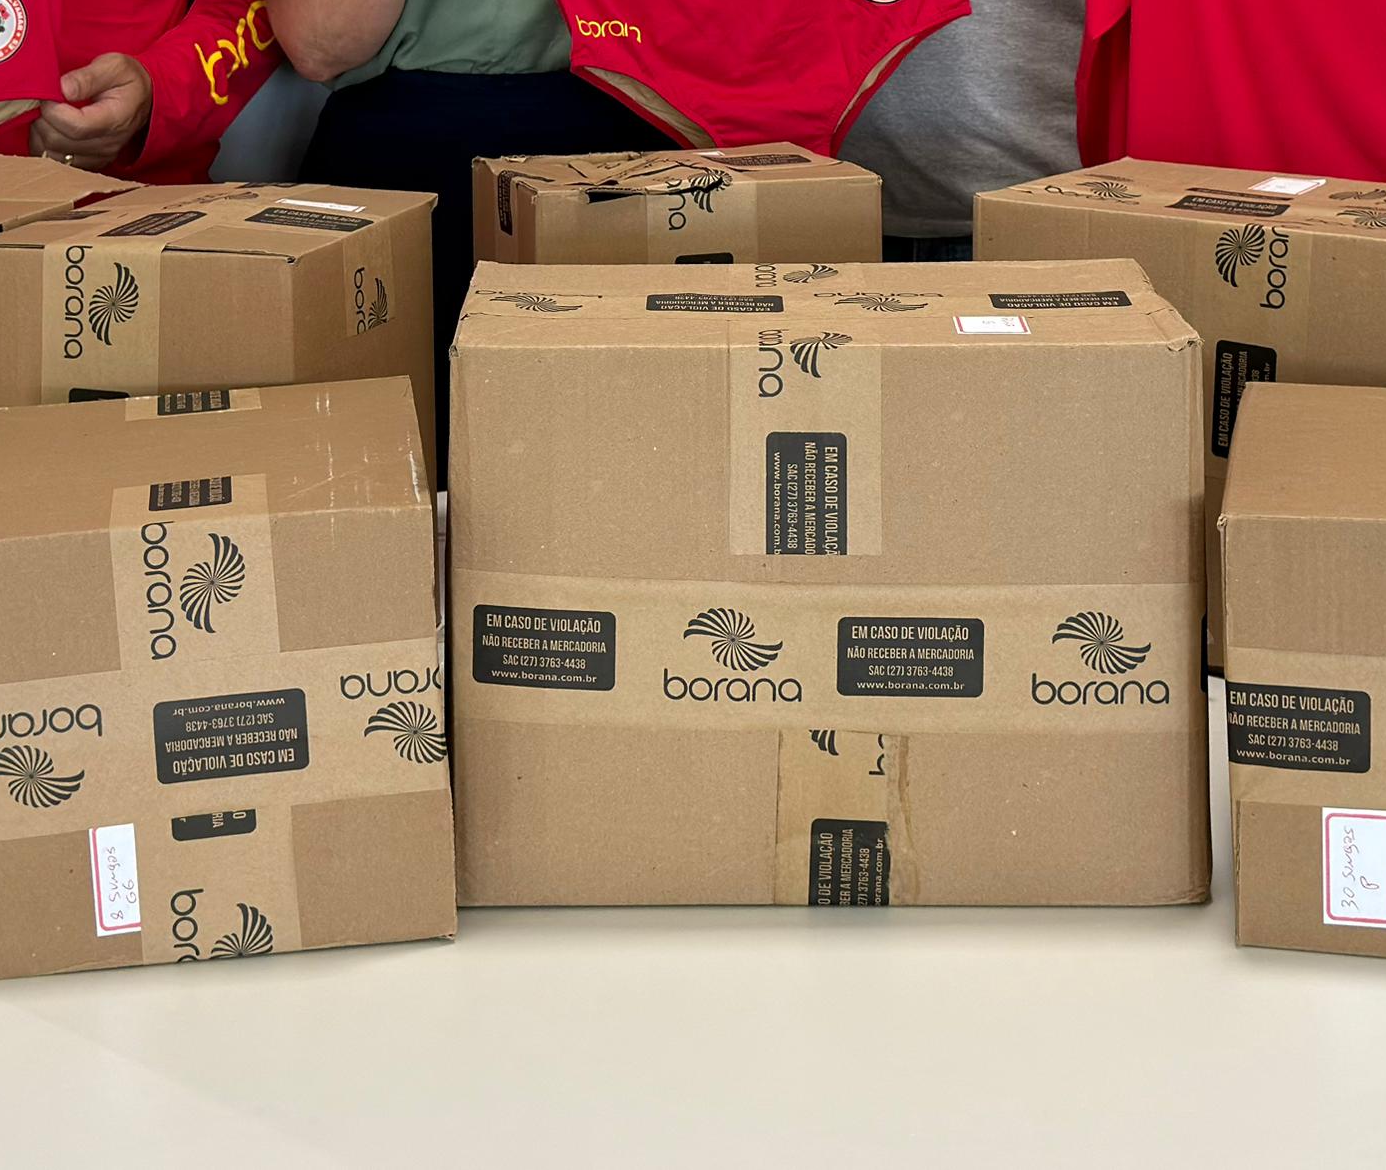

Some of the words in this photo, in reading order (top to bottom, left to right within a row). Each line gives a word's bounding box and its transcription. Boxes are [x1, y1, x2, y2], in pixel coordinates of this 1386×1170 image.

[64, 245, 93, 359] borana
[805, 442, 818, 461] NÃO
[825, 446, 838, 463] EM
[787, 464, 797, 480] SAC
[824, 465, 838, 493] CASO
[805, 462, 816, 502] RECEBER
[787, 483, 797, 502] (27)
[805, 503, 815, 511] A
[825, 495, 838, 510] DE
[787, 504, 797, 549] 3763-4438
[141, 520, 177, 660] borana
[486, 613, 502, 627] EM
[504, 615, 532, 630] CASO
[534, 617, 547, 631] DE
[550, 618, 601, 635] VIOLAÇÃO
[851, 625, 867, 639] EM
[870, 626, 898, 640] CASO
[901, 626, 915, 640] DE
[917, 625, 969, 643] VIOLAÇÃO
[482, 633, 500, 647] NÃO
[502, 636, 540, 650] RECEBER
[542, 639, 548, 651] A
[550, 639, 606, 653] MERCADORIA
[503, 654, 519, 666] SAC
[520, 655, 538, 668] (27)
[539, 657, 586, 669] 3763-4438
[847, 646, 866, 659] NÃO
[867, 648, 907, 659] RECEBER
[909, 648, 916, 659] A
[917, 649, 974, 660] MERCADORIA
[491, 670, 597, 683] www.borana.com.br
[868, 665, 885, 676] SAC
[886, 665, 905, 677] (27)
[906, 665, 954, 677] 3763-4438
[663, 668, 802, 704] borana
[856, 681, 965, 690] www.borana.com.br
[1031, 672, 1170, 706] borana
[172, 697, 285, 717] www.borana.com.br
[1230, 691, 1246, 706] EM
[1249, 693, 1279, 708] CASO
[1282, 695, 1296, 709] DE
[1299, 697, 1354, 715] VIOLAÇÃO
[185, 717, 235, 732] 3763-4438
[237, 714, 255, 727] (27)
[258, 713, 274, 724] SAC
[1247, 715, 1289, 730] RECEBER
[1291, 719, 1298, 730] A
[1299, 719, 1361, 735] MERCADORIA
[165, 734, 224, 753] MERCADORIA
[227, 734, 234, 746] A
[236, 730, 276, 745] RECEBER
[279, 728, 298, 742] NÃO
[1248, 734, 1265, 745] SAC
[1268, 735, 1286, 747] (27)
[1288, 738, 1339, 751] 3763-4438
[230, 754, 244, 767] DE
[246, 750, 275, 766] CASO
[278, 748, 295, 763] EM
[1236, 750, 1351, 765] www.borana.com.br
[173, 756, 227, 776] VIOLAÇÃO
